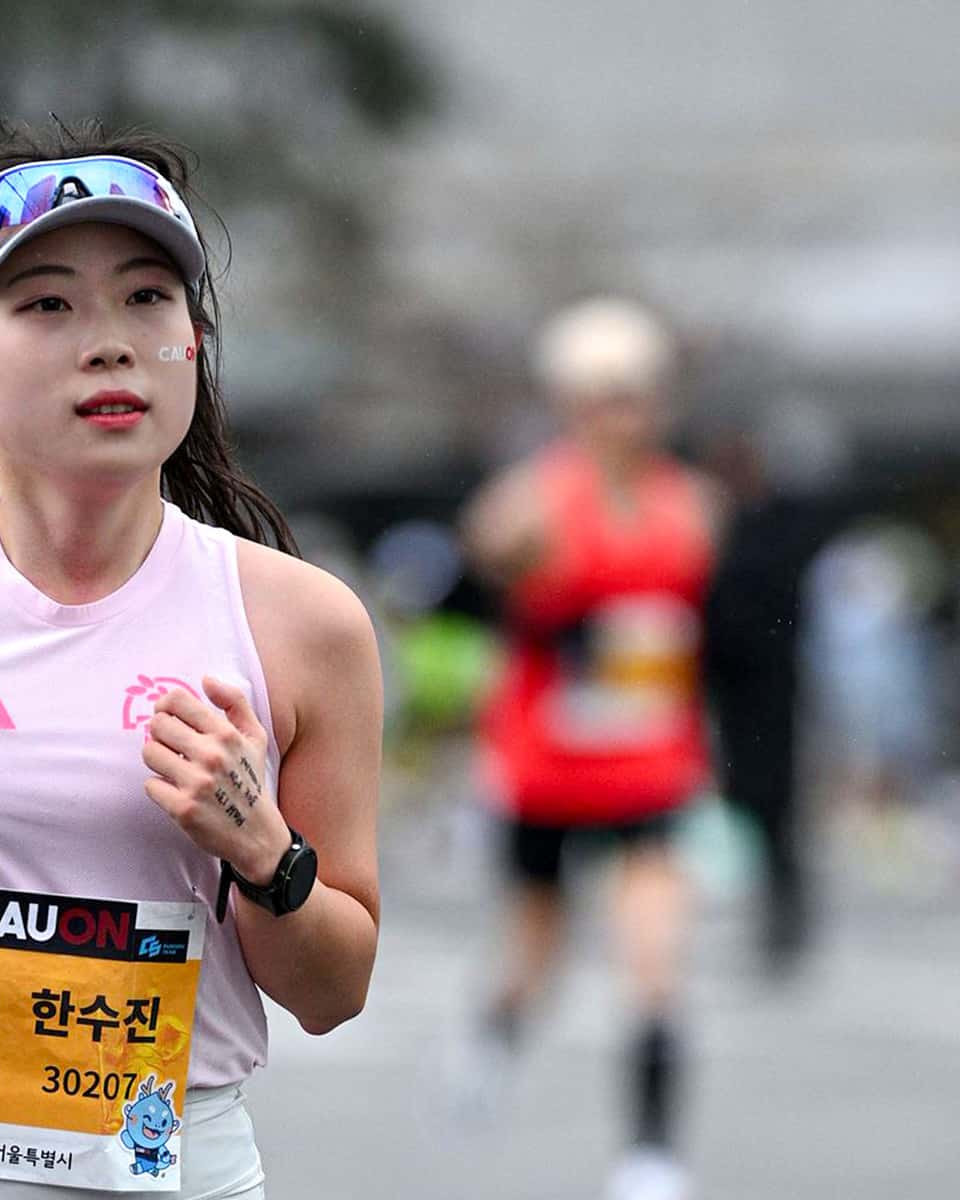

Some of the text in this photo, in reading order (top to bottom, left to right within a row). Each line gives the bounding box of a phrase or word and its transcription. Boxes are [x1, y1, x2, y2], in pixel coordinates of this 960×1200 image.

[159, 346, 195, 362] CAUO
[31, 988, 161, 1044] 한수진
[41, 1066, 138, 1101] 30207
